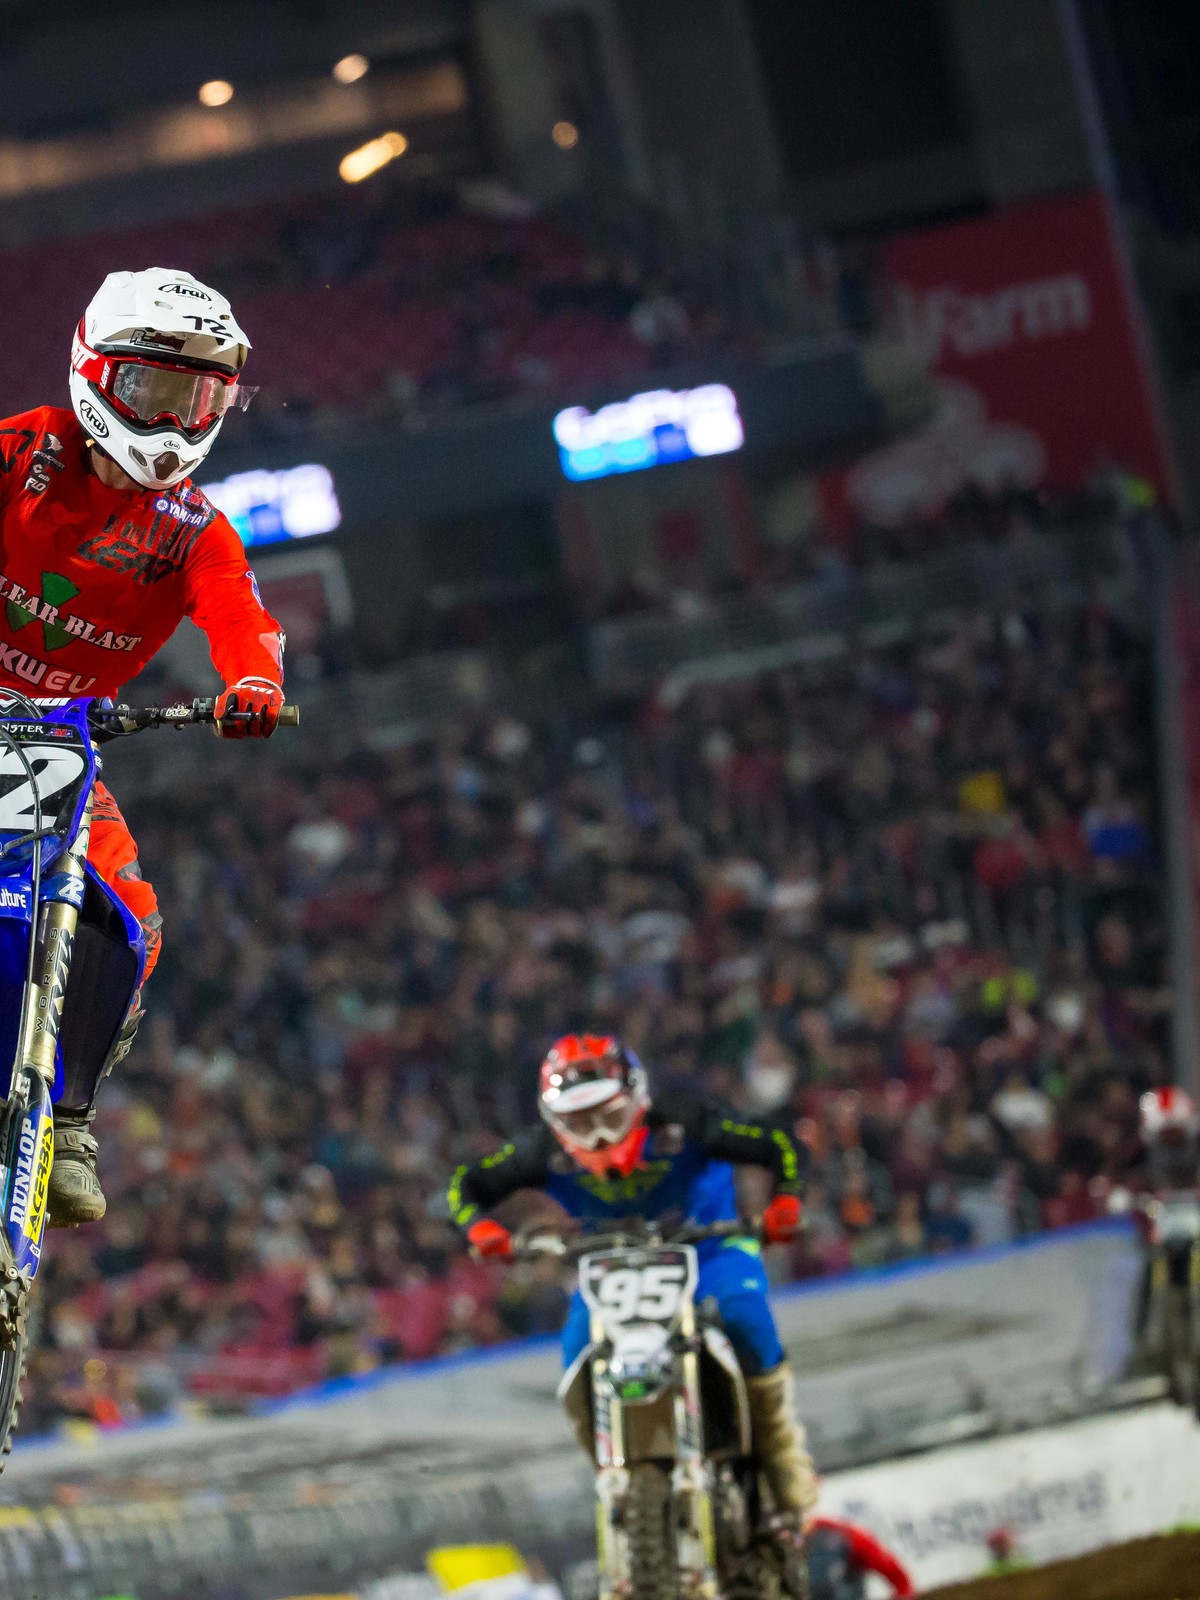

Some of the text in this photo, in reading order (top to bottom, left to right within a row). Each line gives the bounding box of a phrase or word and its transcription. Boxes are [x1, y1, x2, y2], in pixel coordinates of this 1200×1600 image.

[162, 285, 208, 300] Arai
[182, 315, 234, 338] 72
[82, 406, 106, 434] Arai
[165, 440, 180, 449] Arai
[63, 615, 142, 651] BLAST
[9, 1117, 37, 1229] DUNLOP
[599, 1264, 685, 1325] 95
